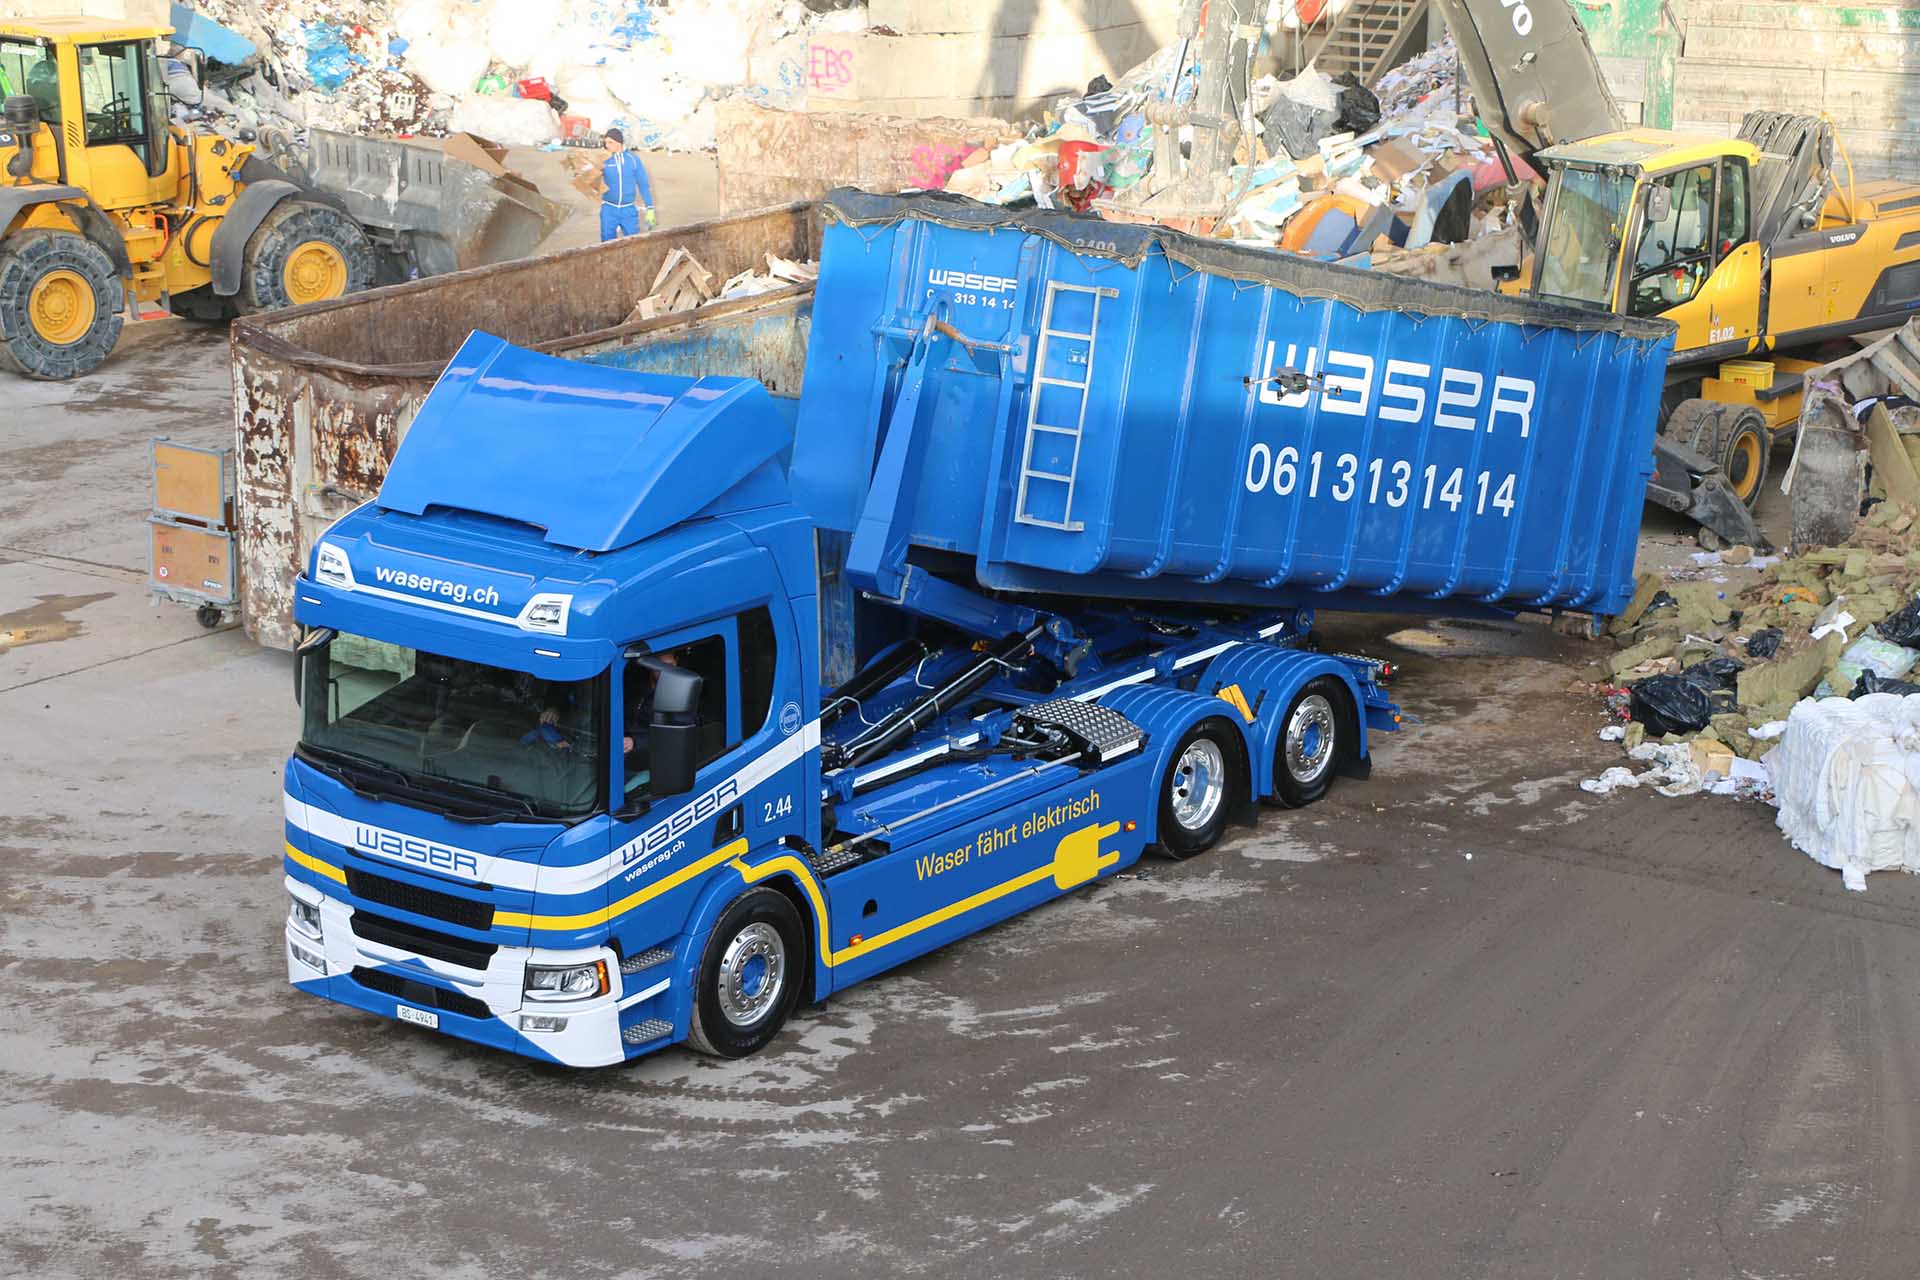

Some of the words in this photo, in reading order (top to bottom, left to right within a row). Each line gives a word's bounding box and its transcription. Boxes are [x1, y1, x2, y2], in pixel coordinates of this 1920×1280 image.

[808, 45, 854, 84] EBS
[1830, 233, 1856, 243] VOLVO
[954, 292, 976, 305] 313
[981, 296, 997, 308] 14
[1710, 326, 1735, 343] E1.02
[375, 566, 499, 606] waserag.ch
[764, 794, 792, 823] 2.44
[915, 843, 973, 881] Waser
[976, 823, 1018, 857] fährt
[1022, 789, 1100, 839] elektrisch
[624, 839, 686, 882] waserag.ch
